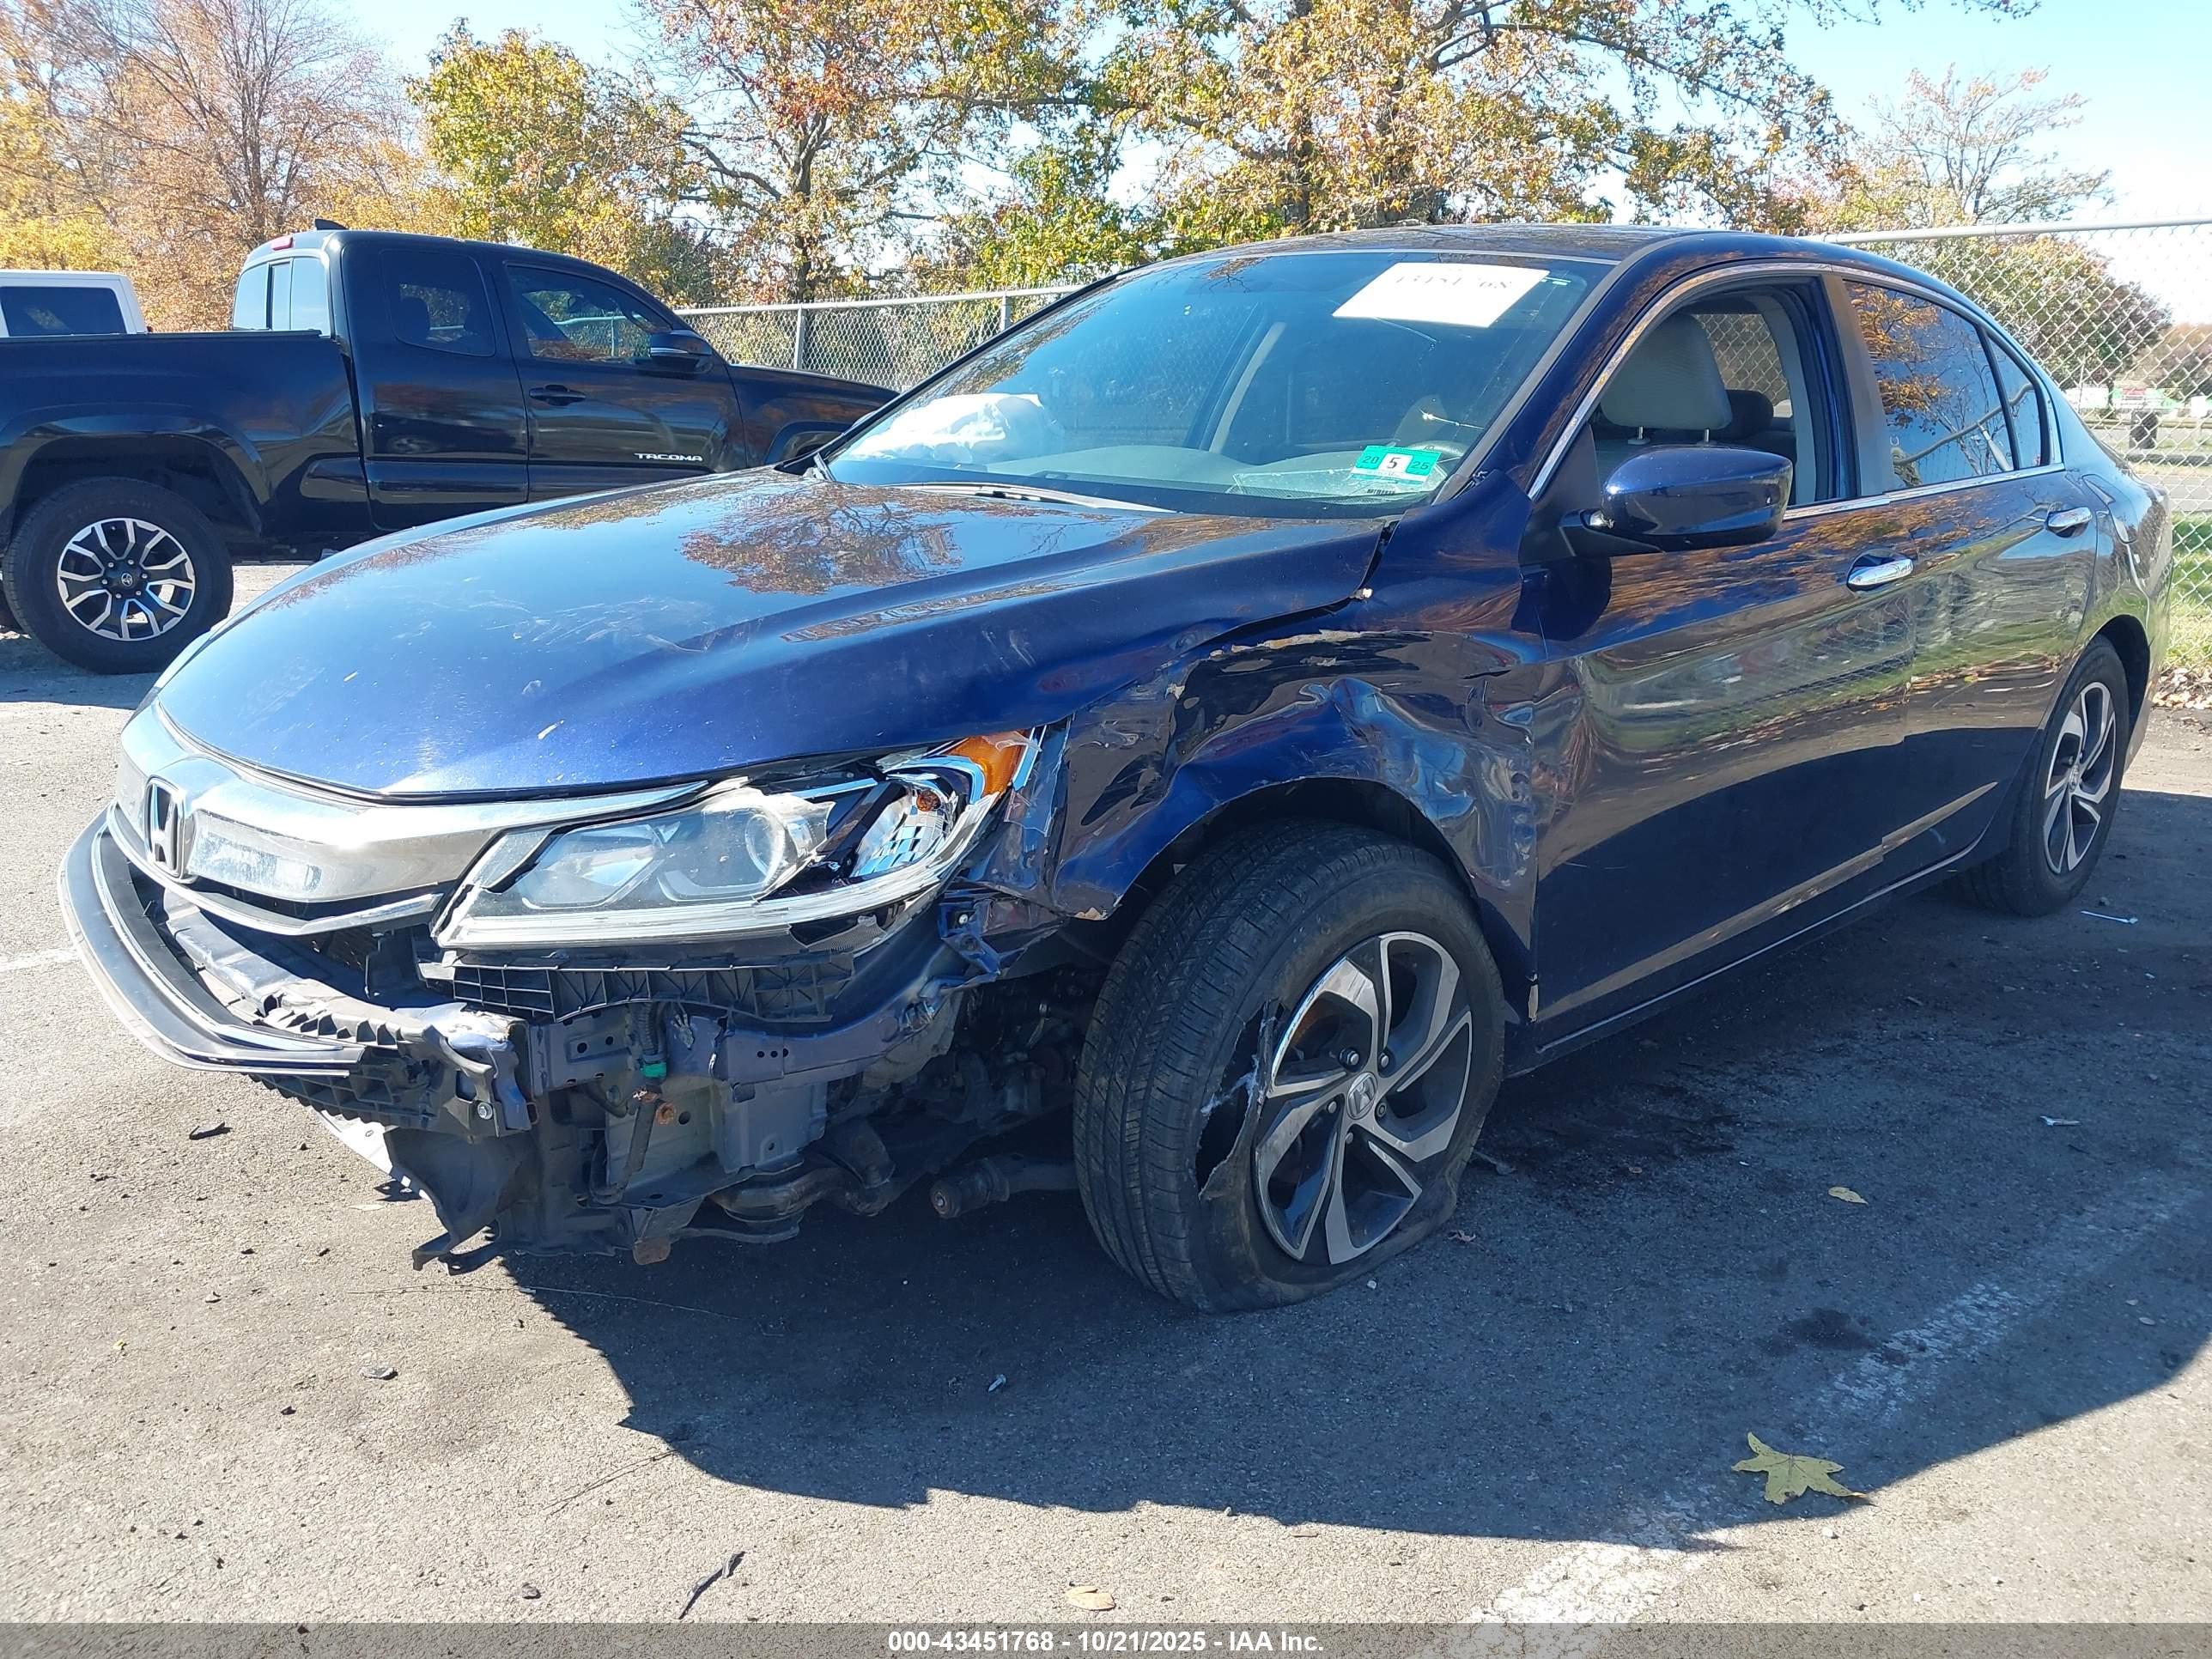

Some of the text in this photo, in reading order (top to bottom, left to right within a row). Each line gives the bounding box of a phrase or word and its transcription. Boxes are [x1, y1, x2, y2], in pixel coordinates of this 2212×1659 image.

[634, 453, 703, 461] TACOMA
[1362, 456, 1430, 471] 20 5 25
